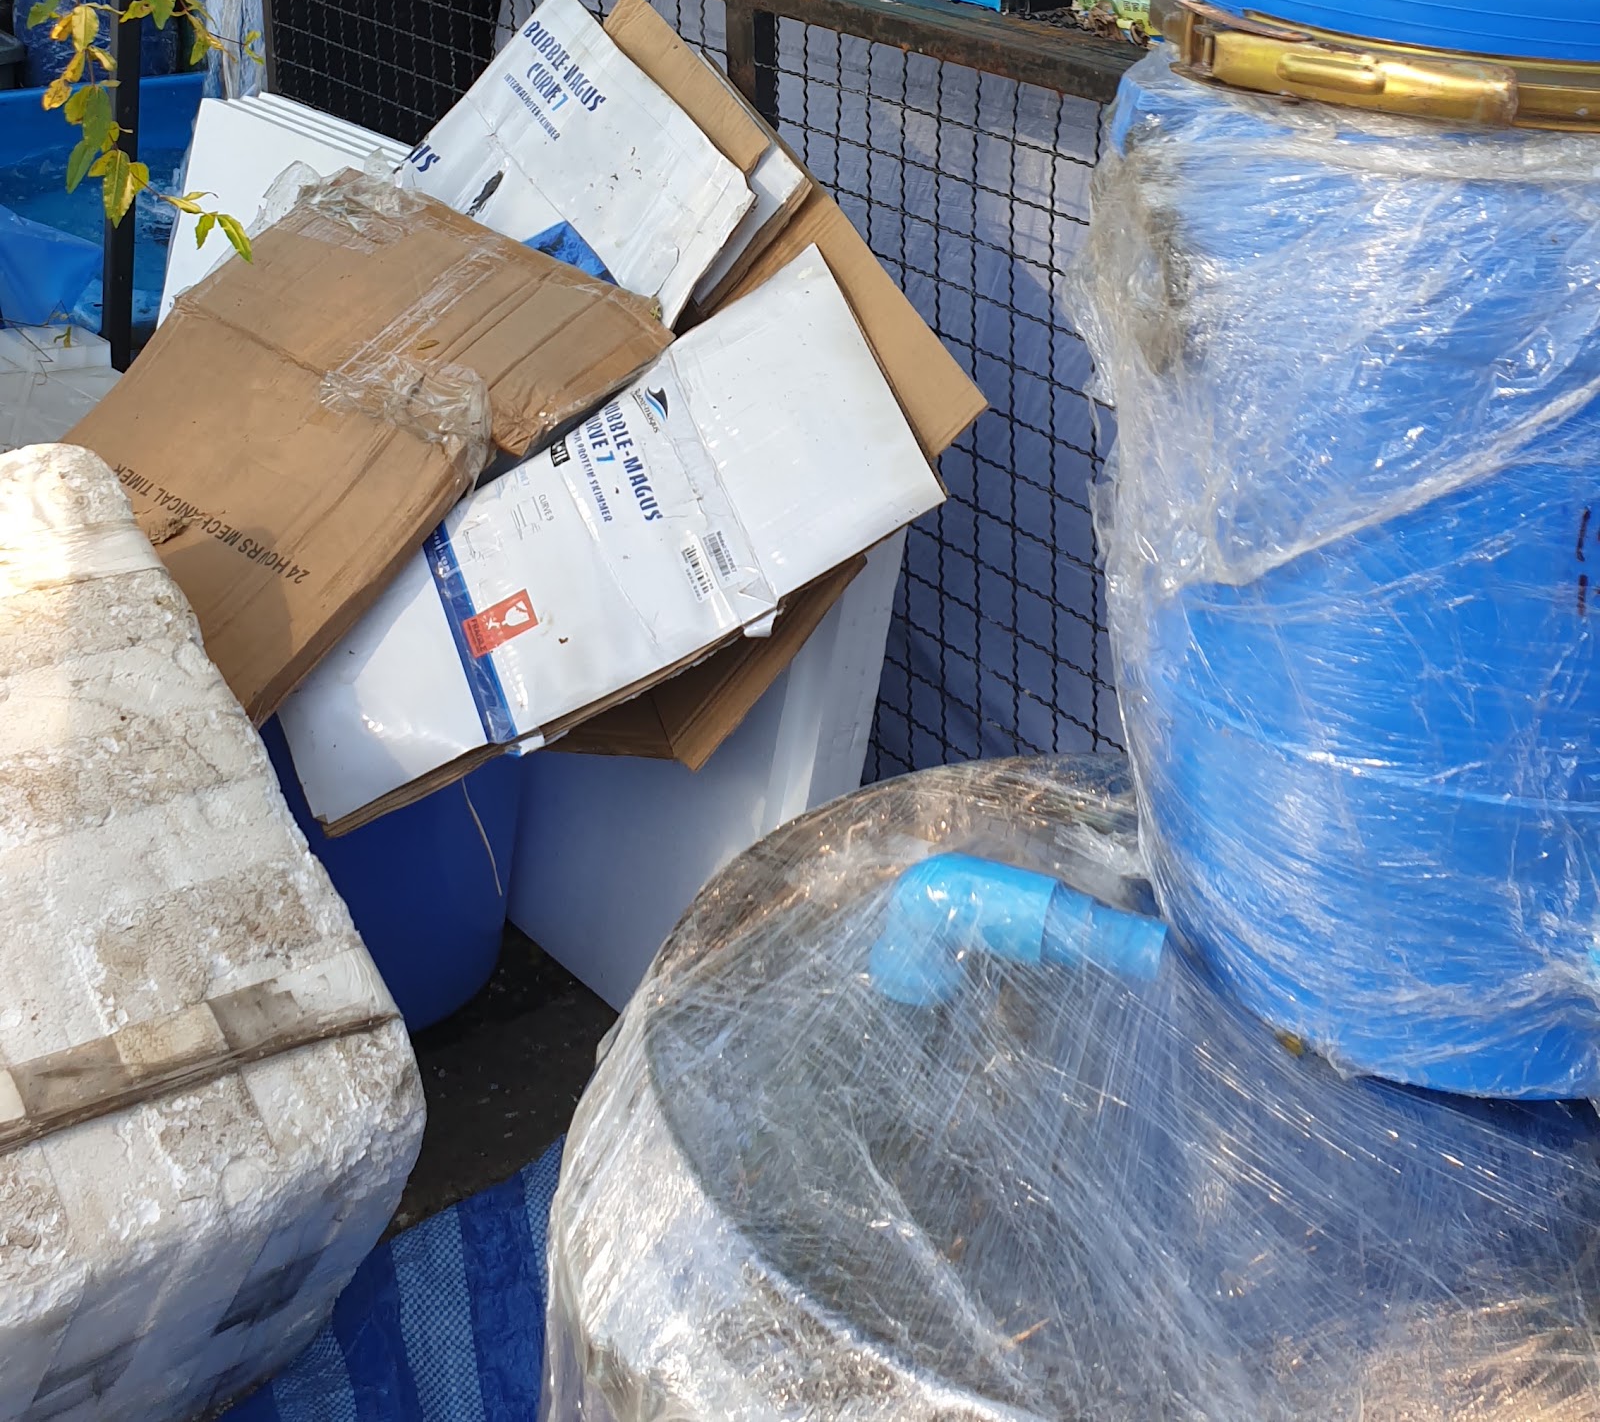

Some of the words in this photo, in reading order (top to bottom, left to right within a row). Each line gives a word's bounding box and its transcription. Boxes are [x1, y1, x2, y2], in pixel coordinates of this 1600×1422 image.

[526, 62, 563, 105] CURVE
[584, 412, 610, 451] URVE
[595, 450, 616, 463] 7
[538, 493, 553, 516] CURVE
[588, 479, 614, 523] SKIMMER
[286, 564, 311, 585] 24
[471, 618, 488, 653] FRAGILE
